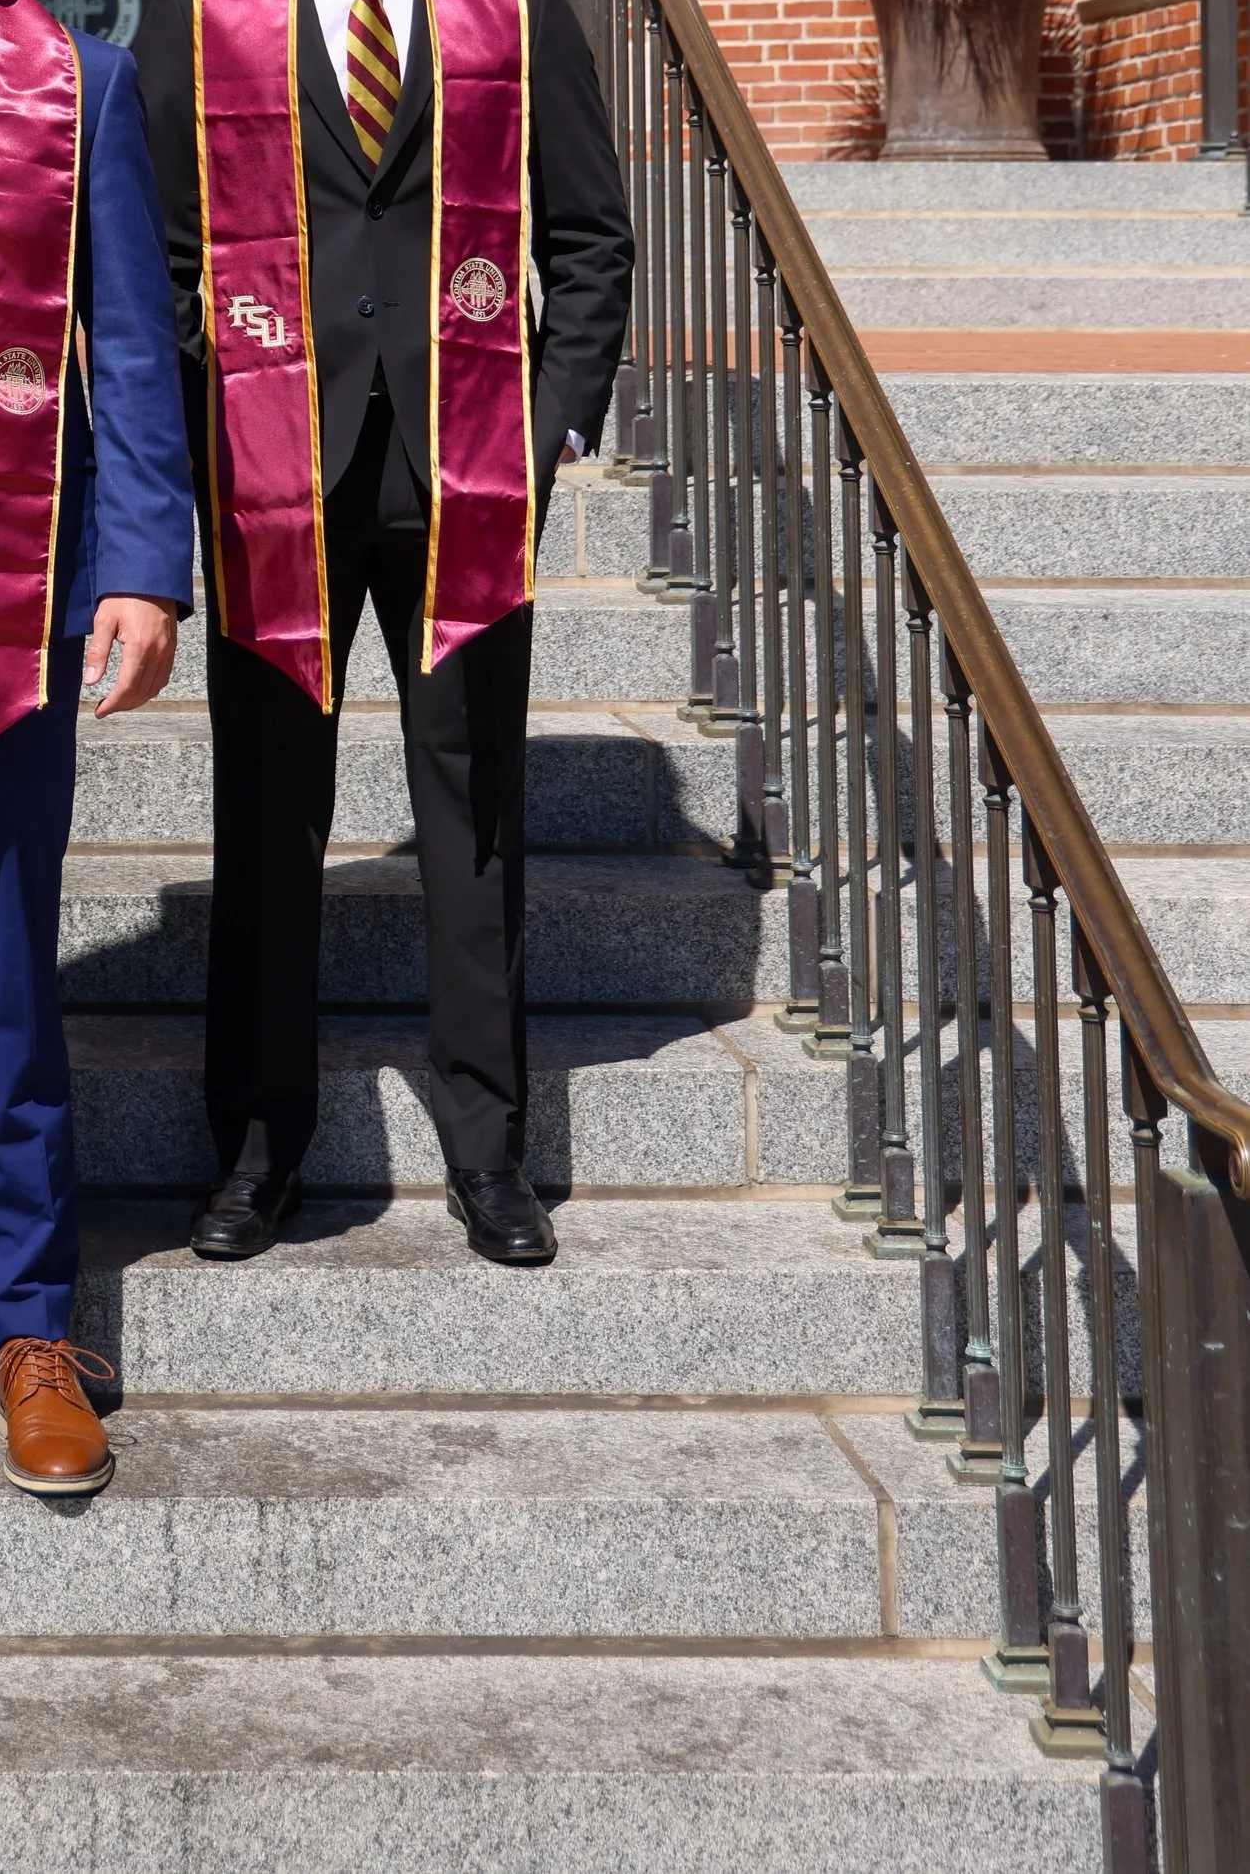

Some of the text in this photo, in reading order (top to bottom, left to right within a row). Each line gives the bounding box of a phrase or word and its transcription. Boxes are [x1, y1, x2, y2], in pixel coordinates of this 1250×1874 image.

[464, 261, 485, 272] STATE
[227, 295, 287, 348] FSU
[2, 351, 27, 362] STATE
